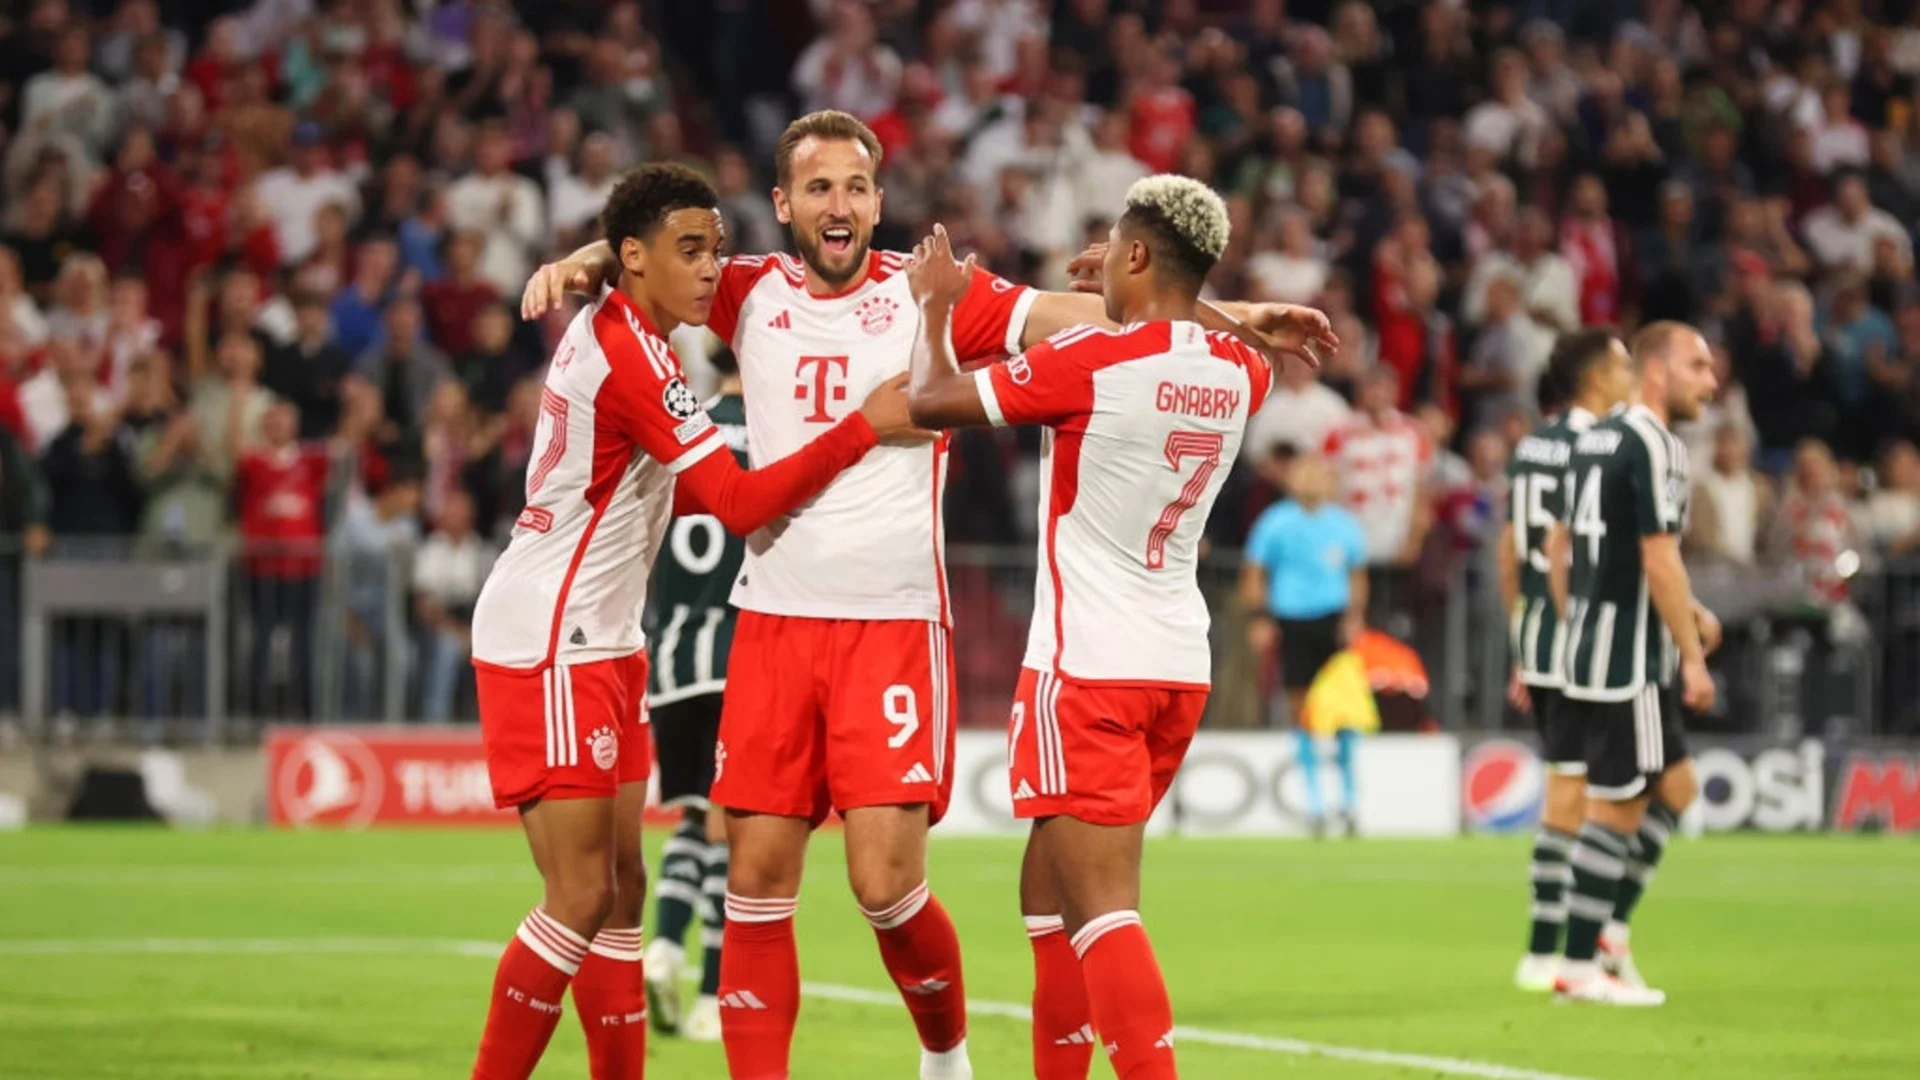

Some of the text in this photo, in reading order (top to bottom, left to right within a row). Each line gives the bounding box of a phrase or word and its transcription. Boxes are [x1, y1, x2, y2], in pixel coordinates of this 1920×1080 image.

[795, 356, 849, 423] T
[1156, 381, 1240, 420] GNABRY
[1146, 430, 1223, 569] 7
[1512, 472, 1559, 573] 15
[883, 684, 919, 747] 9
[506, 986, 525, 1003] FC
